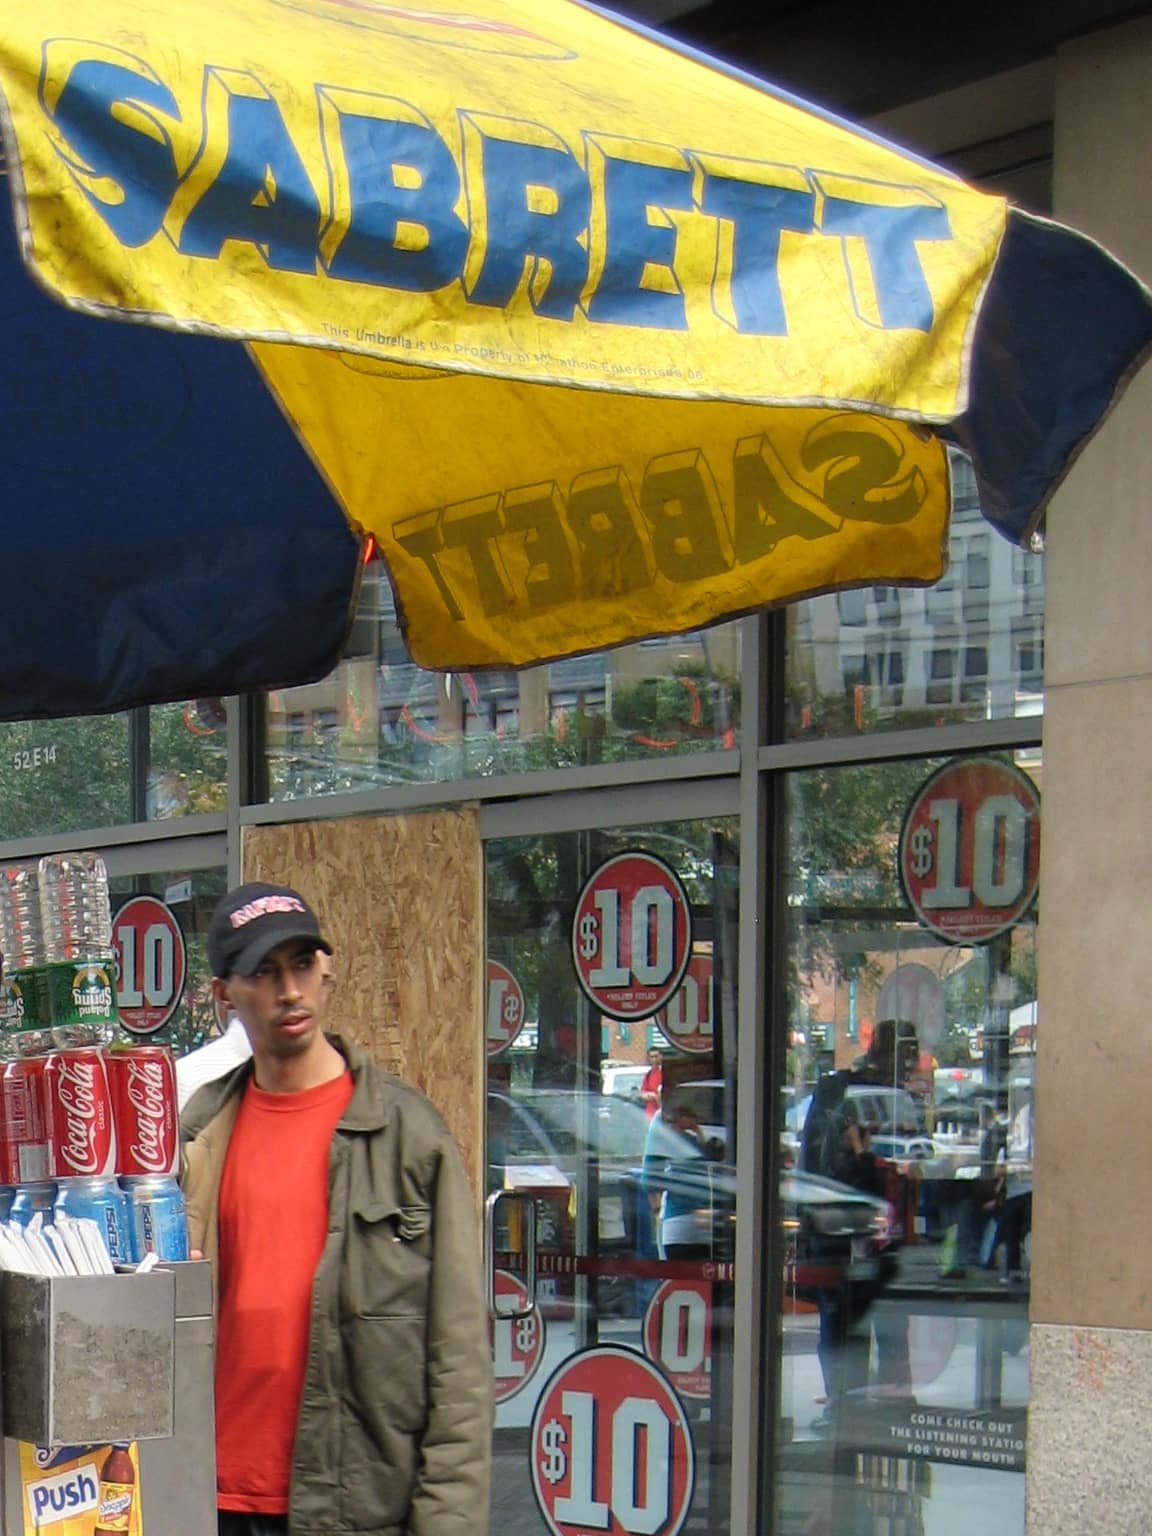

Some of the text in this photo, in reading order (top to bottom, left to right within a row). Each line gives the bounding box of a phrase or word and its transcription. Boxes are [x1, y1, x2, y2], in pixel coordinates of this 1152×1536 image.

[39, 37, 953, 338] SABRETT
[321, 323, 349, 338] This
[356, 329, 412, 350] Umbrella
[416, 339, 426, 350] is
[453, 343, 513, 363] Property
[14, 750, 31, 770] 52
[911, 795, 1027, 909] $10
[579, 885, 674, 988] $10
[72, 985, 111, 1012] Spring
[78, 1004, 110, 1018] Poland
[57, 1056, 100, 1174] Coca-Cola
[127, 1056, 169, 1174] Coca-Cola
[105, 1206, 122, 1265] PEPSI
[142, 1204, 155, 1242] PEPSI
[890, 1425, 1025, 1451] THE LISTENING STATIO
[910, 1412, 1014, 1434] COME CHECK OUT
[540, 1390, 671, 1536] $10
[907, 1442, 1016, 1466] FOR YOUR MOUTH
[32, 1473, 97, 1517] Push
